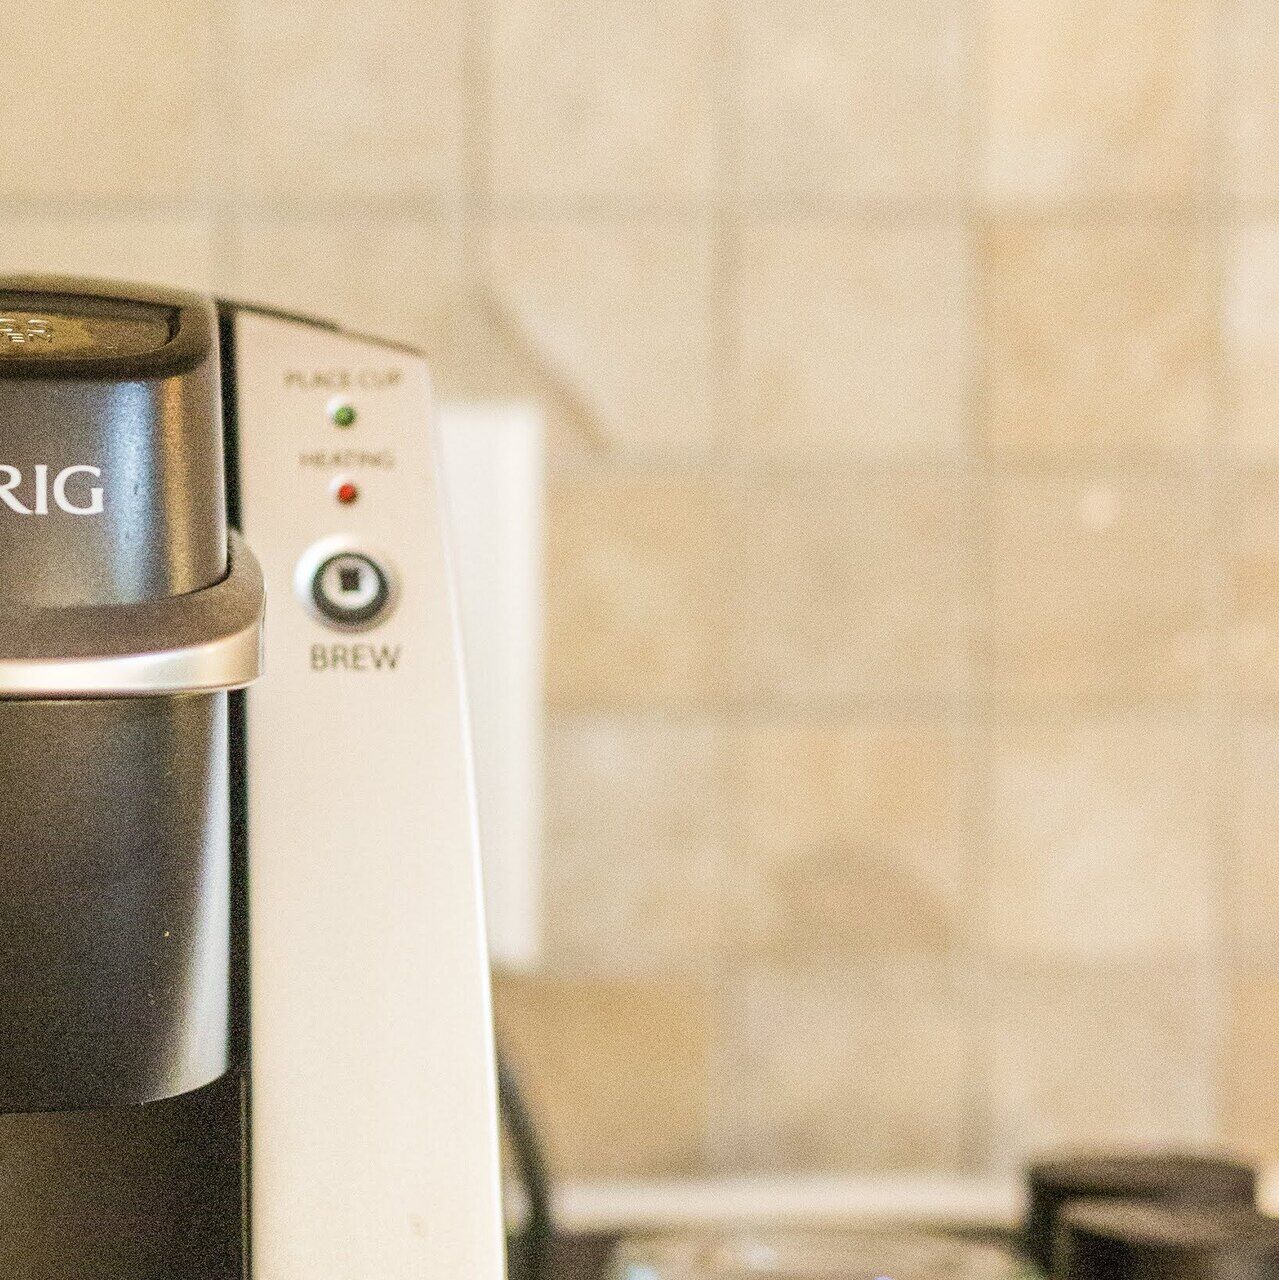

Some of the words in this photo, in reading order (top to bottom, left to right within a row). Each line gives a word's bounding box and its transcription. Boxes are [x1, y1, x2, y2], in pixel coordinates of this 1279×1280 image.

[282, 369, 350, 389] PLACE
[358, 367, 402, 388] CUP
[298, 450, 394, 469] HEATING
[310, 644, 402, 672] BREW
